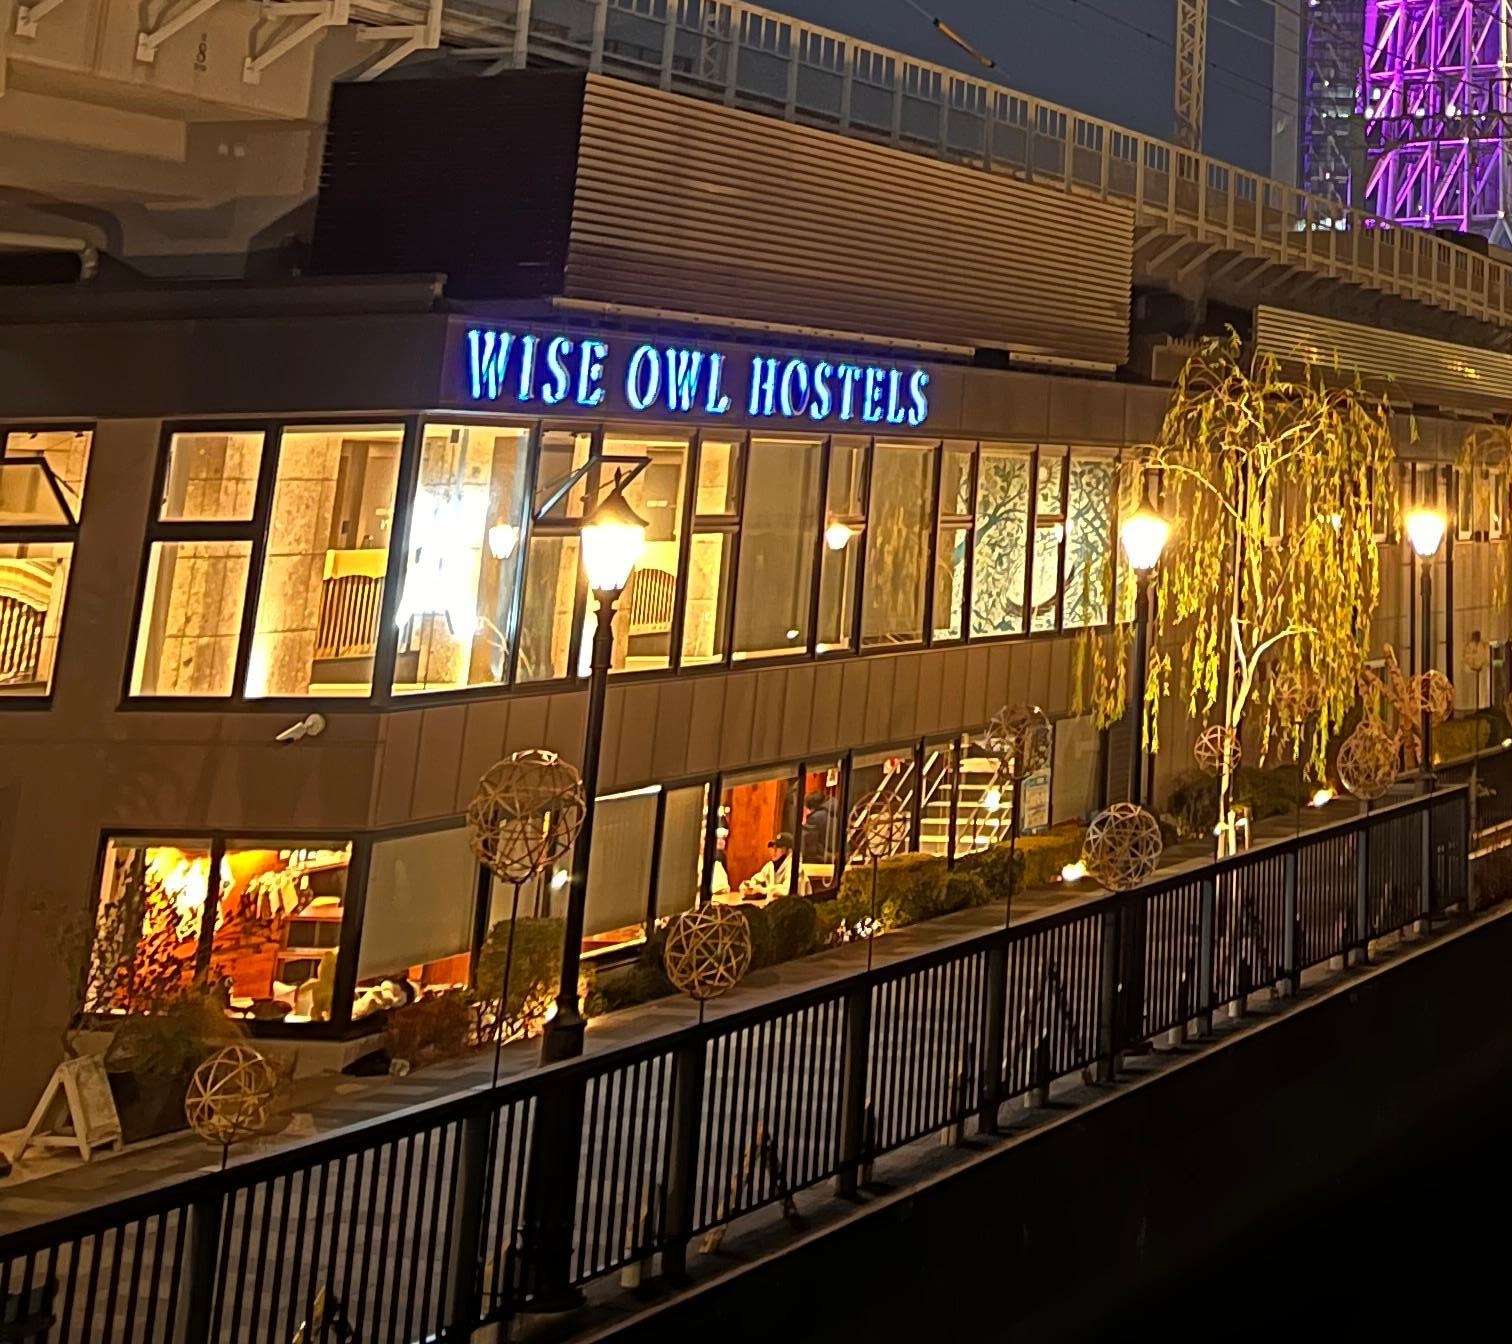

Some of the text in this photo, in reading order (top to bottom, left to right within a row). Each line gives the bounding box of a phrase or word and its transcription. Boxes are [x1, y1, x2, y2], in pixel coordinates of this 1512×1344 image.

[467, 329, 929, 427] WISE OWL HOSTELS
